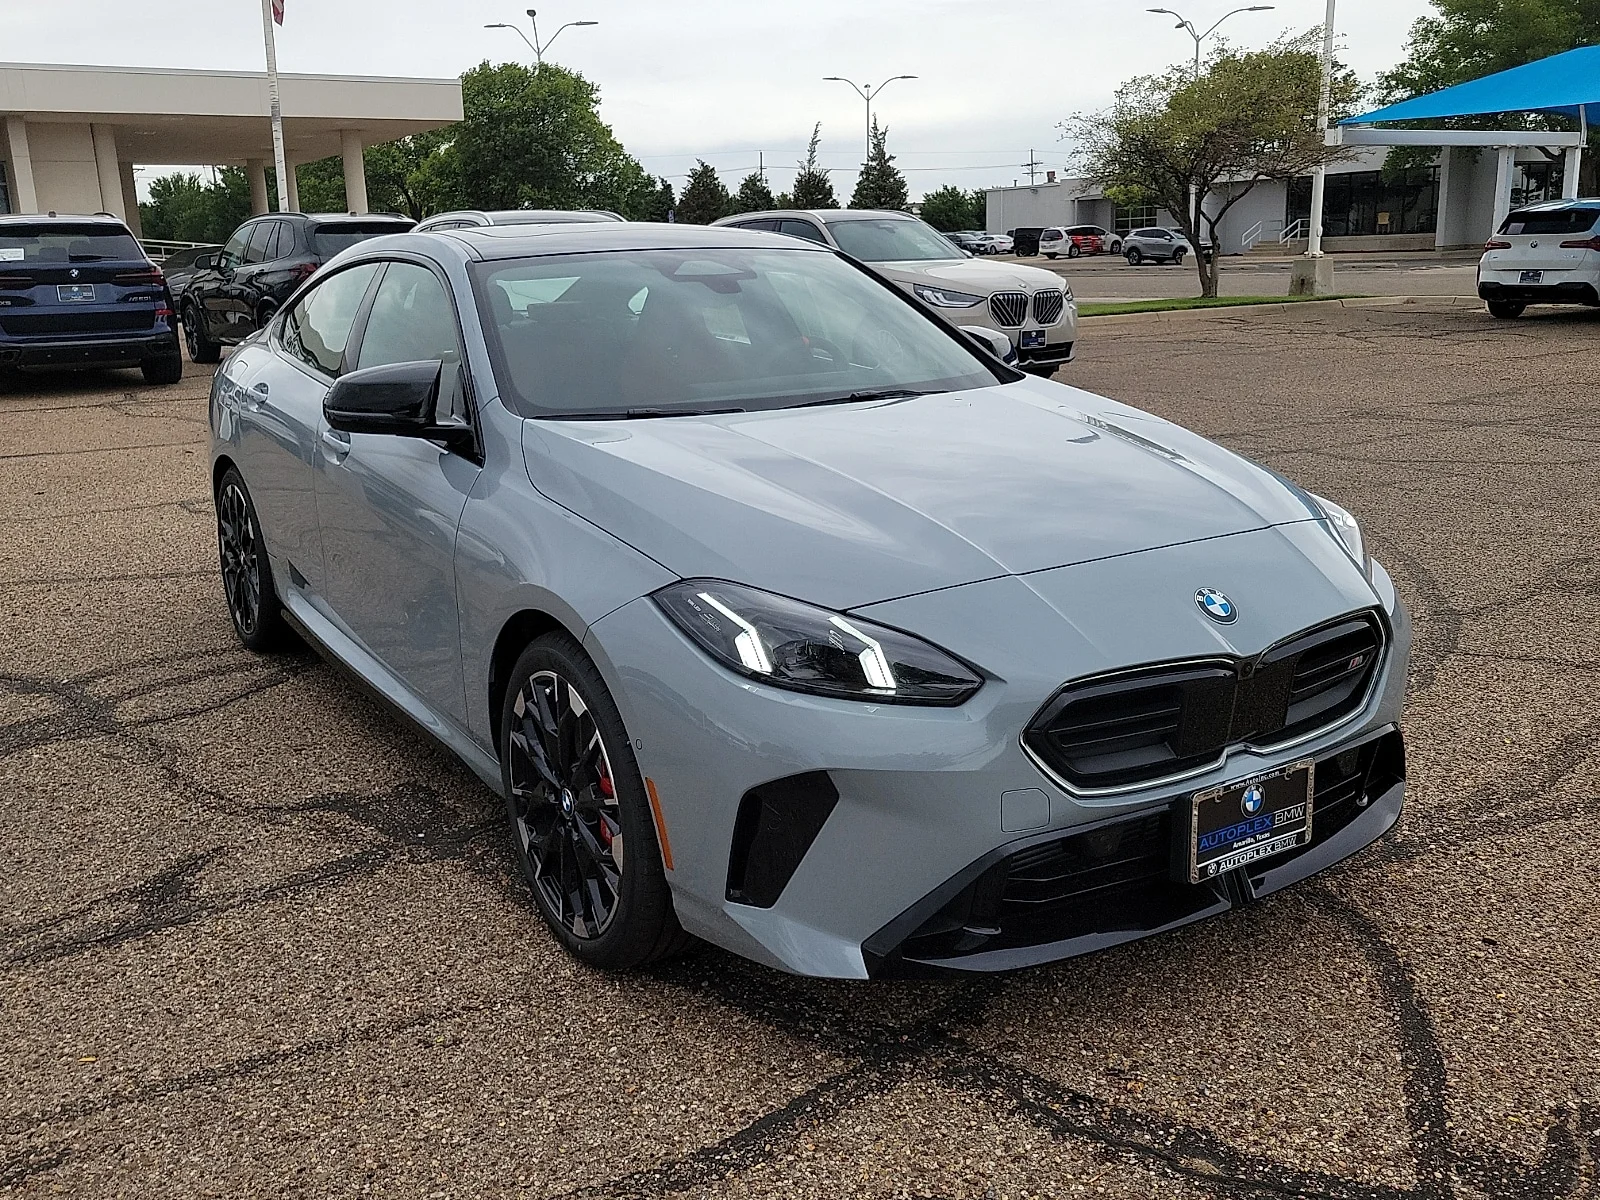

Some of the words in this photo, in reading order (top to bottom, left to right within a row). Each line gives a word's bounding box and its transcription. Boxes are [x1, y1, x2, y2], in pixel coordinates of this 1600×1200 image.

[1200, 815, 1273, 850] AUTOPLEX
[1274, 805, 1305, 825] BMW
[1256, 832, 1271, 842] Texas
[1219, 844, 1272, 871] AUTOPLEX
[1274, 836, 1297, 851] BMW
